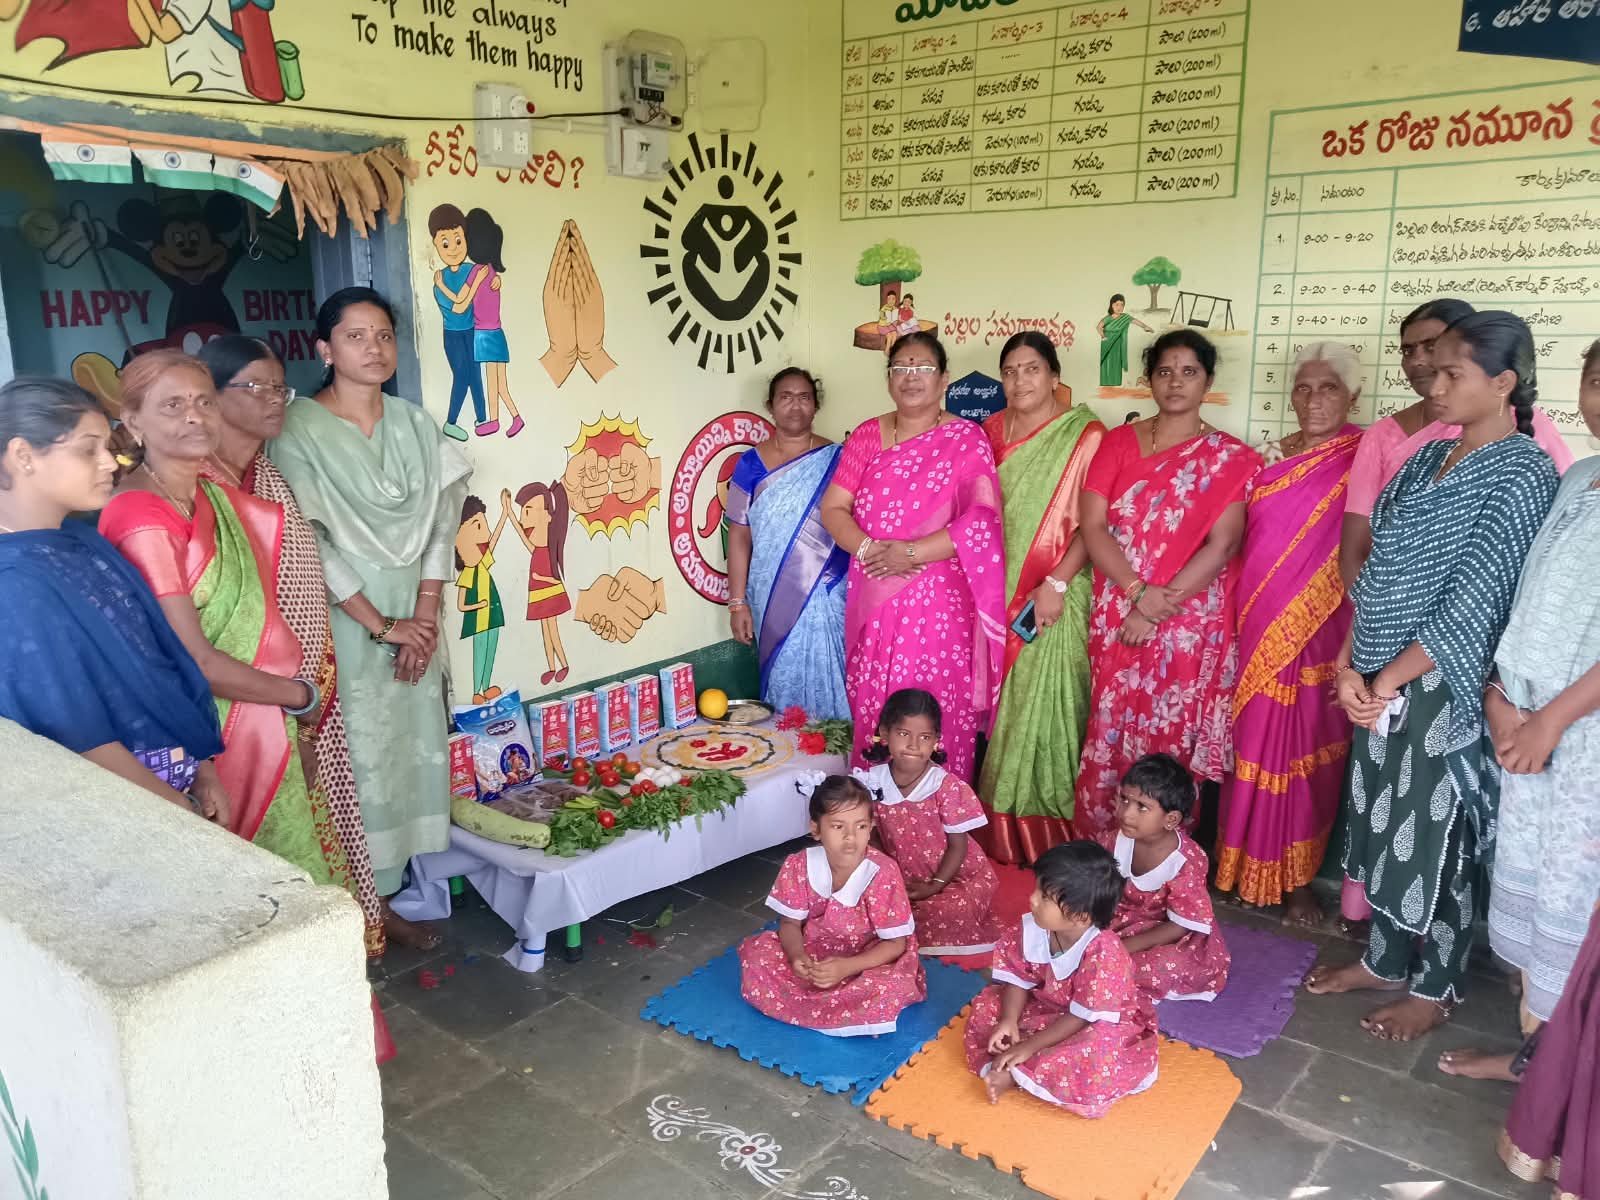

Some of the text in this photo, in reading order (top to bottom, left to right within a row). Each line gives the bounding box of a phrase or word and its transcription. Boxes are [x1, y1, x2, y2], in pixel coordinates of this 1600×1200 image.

[472, 0, 557, 44] always
[351, 13, 583, 92] To make them happy
[1321, 120, 1370, 158] ఒక
[1376, 110, 1441, 153] రోజు
[496, 150, 584, 189] వాలి?
[40, 289, 152, 328] HAPPY
[268, 329, 319, 361] DAY
[733, 418, 769, 443] కాపా
